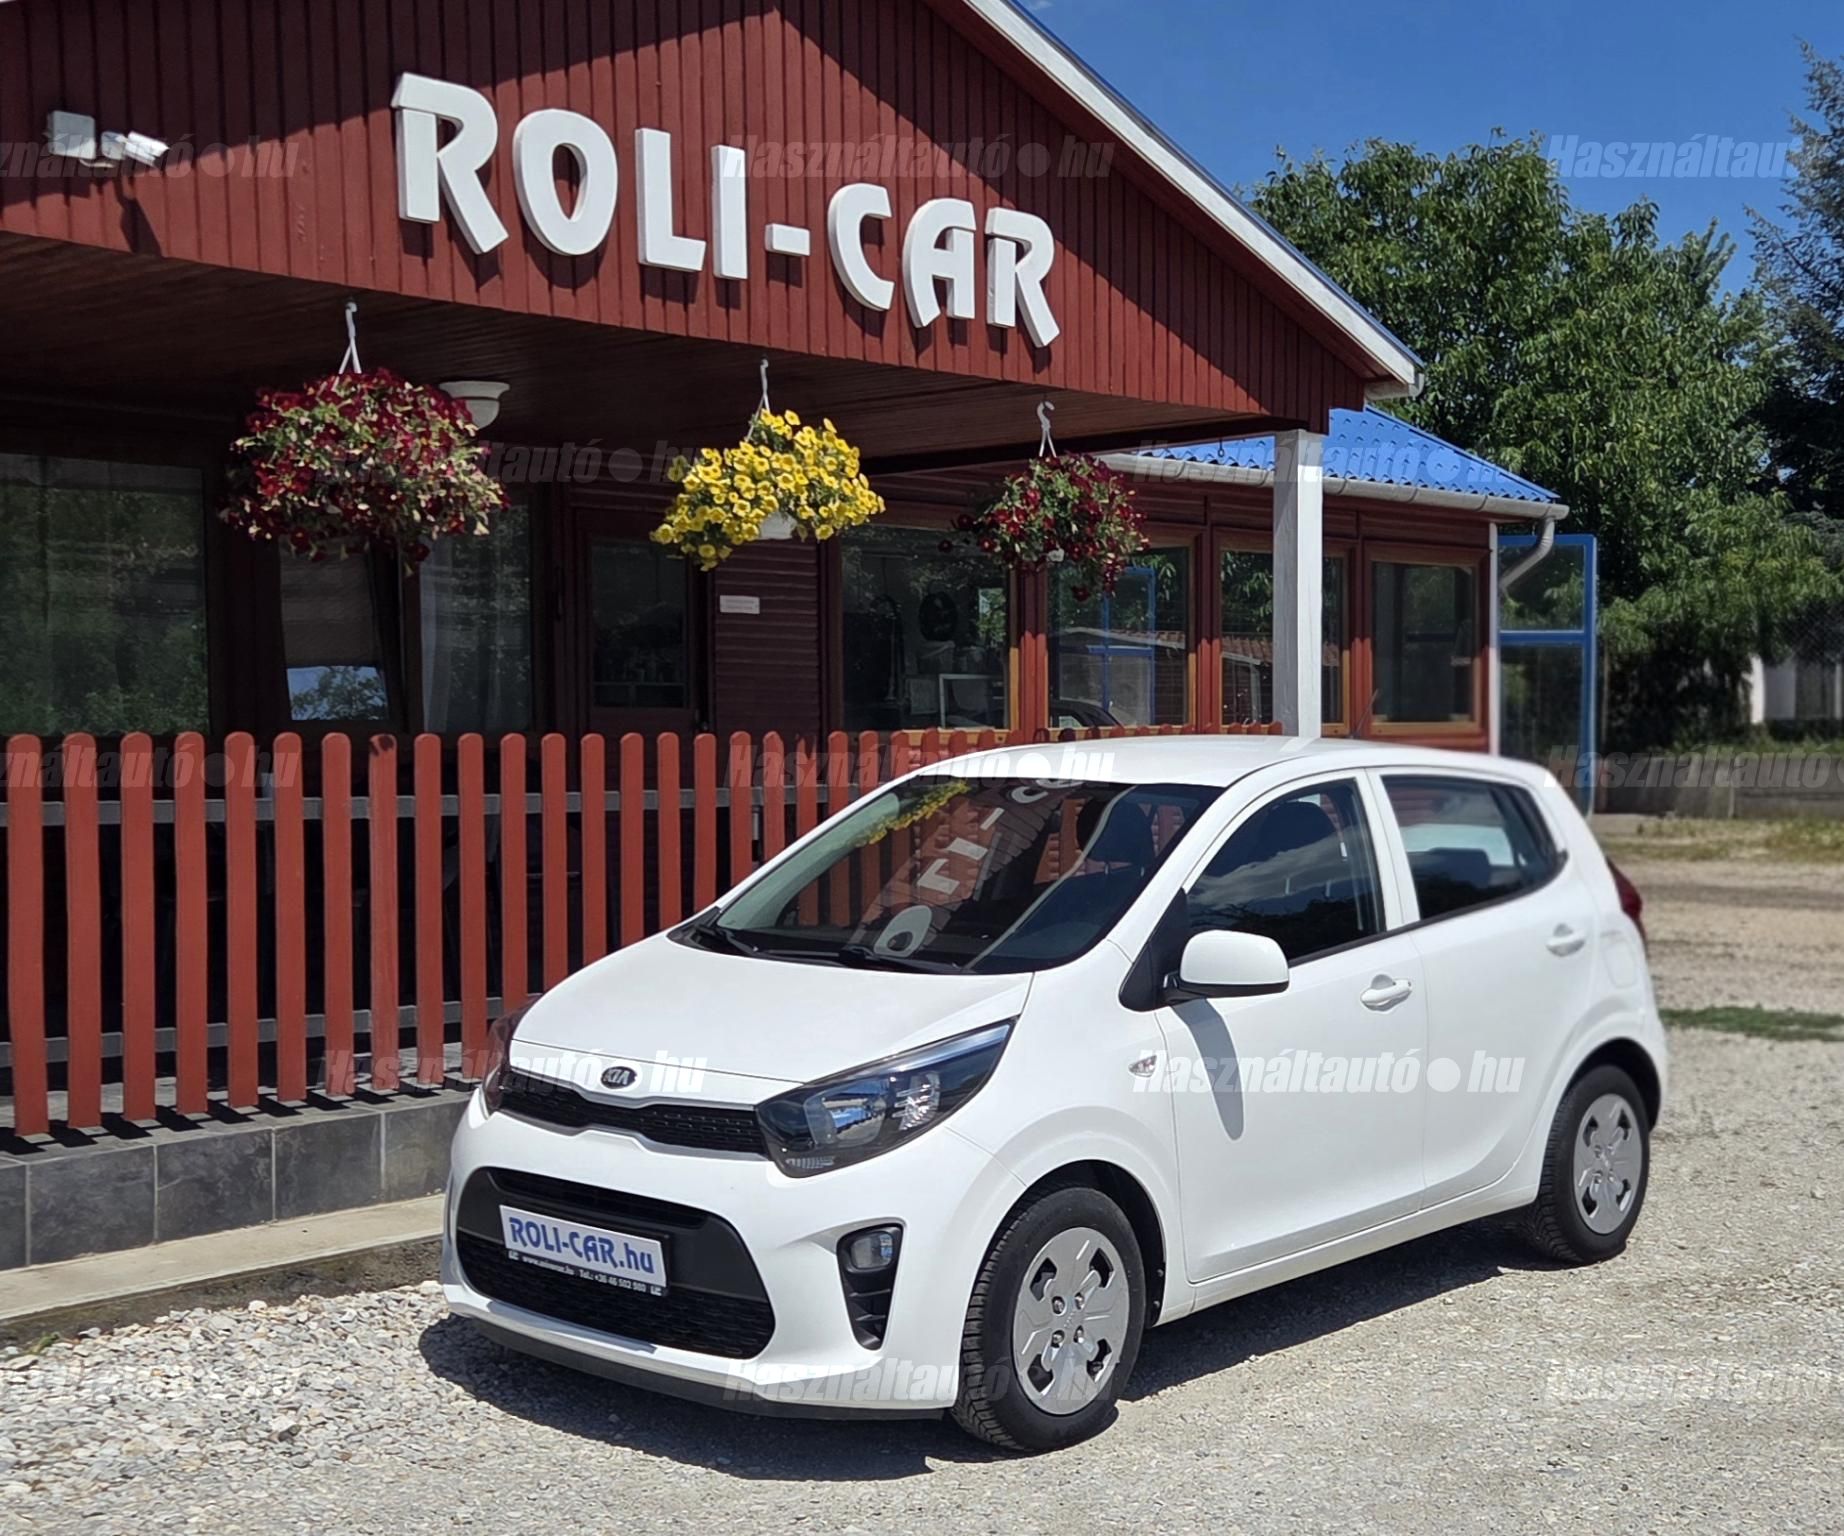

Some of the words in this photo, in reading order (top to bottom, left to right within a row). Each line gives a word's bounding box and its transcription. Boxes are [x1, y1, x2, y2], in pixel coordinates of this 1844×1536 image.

[391, 71, 1060, 349] ROLI-CAR
[602, 1067, 631, 1086] KIA
[508, 1216, 655, 1274] ROLI-CAR.hu
